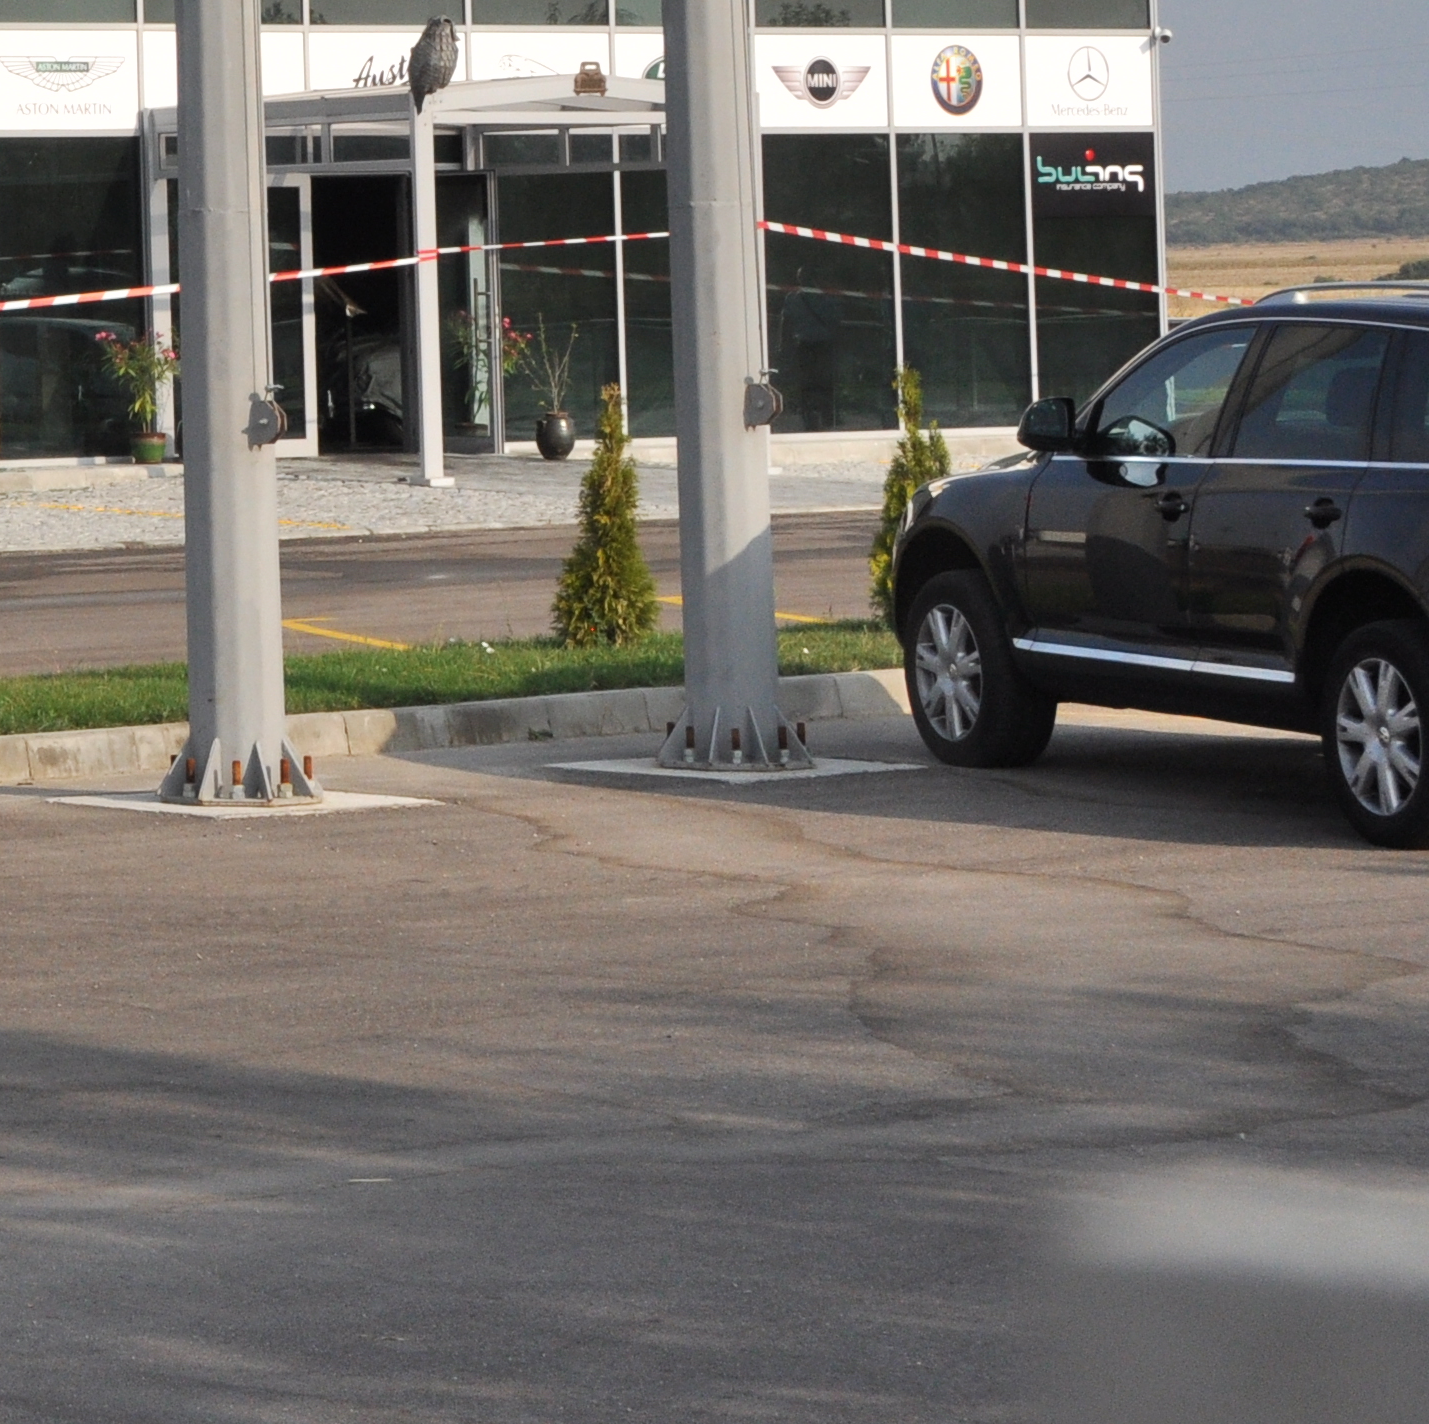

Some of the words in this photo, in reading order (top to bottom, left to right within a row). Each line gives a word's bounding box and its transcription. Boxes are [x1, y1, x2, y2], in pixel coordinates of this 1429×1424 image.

[37, 63, 61, 72] ASTON
[61, 63, 88, 72] MARTIN
[352, 55, 410, 88] Aust
[807, 73, 837, 88] MINI
[16, 102, 59, 115] ASTON
[63, 102, 112, 115] MARTIN
[1051, 103, 1128, 116] Mercedes-Benz
[1056, 183, 1092, 191] insurance
[1092, 183, 1126, 192] company
